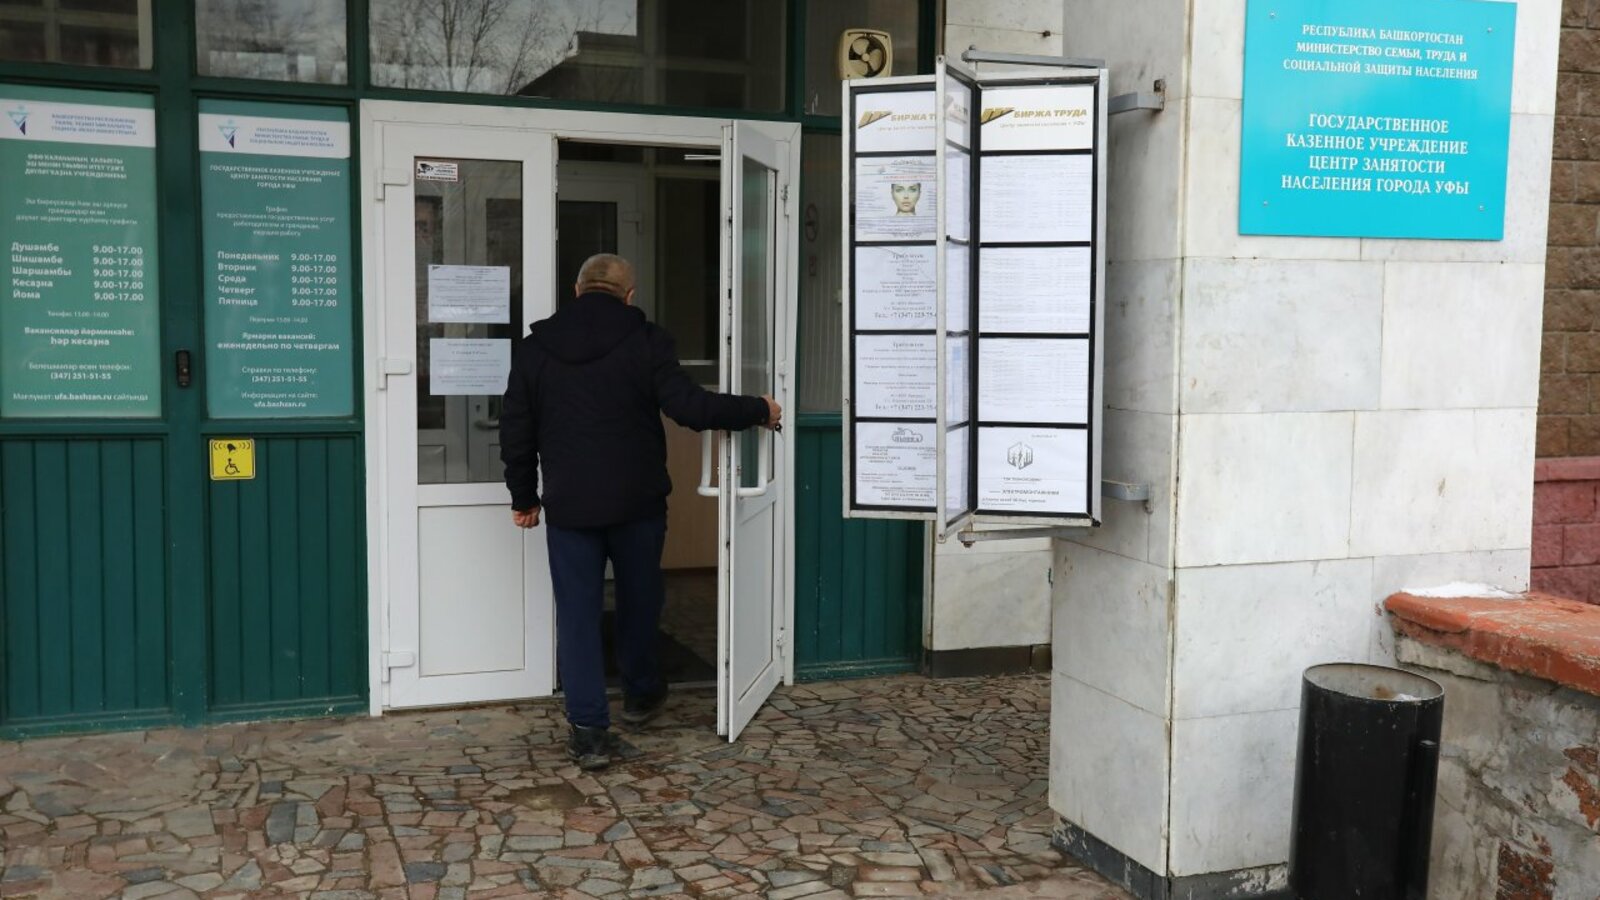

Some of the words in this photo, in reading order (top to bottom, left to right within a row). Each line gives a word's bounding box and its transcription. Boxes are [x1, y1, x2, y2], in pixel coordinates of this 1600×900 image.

[1302, 24, 1376, 39] РЕСПУБЛИКА
[1379, 29, 1464, 45] БАШКОРТОСТАН
[1296, 42, 1382, 56] МИНИСТЕРСТВО
[1385, 46, 1422, 60] СЕМЬИ,
[1425, 49, 1456, 62] ТРУДА
[1459, 51, 1467, 62] И
[1283, 58, 1361, 75] СОЦИАЛЬНОЙ
[1364, 63, 1412, 77] ЗАЩИТЫ
[1415, 66, 1478, 80] НАСЕЛЕНИЯ
[1013, 110, 1052, 119] БИРЖА
[1054, 108, 1087, 117] ТРУДА
[1309, 113, 1449, 133] ГОСУДАРСТВЕННОЕ
[1286, 133, 1365, 150] КАЗЕННОЕ
[1369, 138, 1468, 155] УЧРЕЖДЕНИЕ
[1309, 155, 1358, 172] ЦЕНТР
[1363, 158, 1445, 174] ЗАНЯТОСТИ
[1281, 175, 1371, 192] НАСЕЛЕНИЯ
[1376, 178, 1430, 194] ГОРОДА
[1435, 180, 1470, 195] УФЫ
[92, 245, 143, 255] 9.00-17.00
[93, 256, 143, 266] 9.00-17.00
[217, 251, 280, 261] Понедельник
[291, 253, 337, 262] 9.00-17.00
[93, 268, 143, 278] 9.00-17.00
[217, 263, 257, 272] Вторник
[291, 264, 337, 273] 9.00-17.00
[94, 280, 144, 290] 9.00-17.00
[218, 274, 246, 283] Среда
[291, 276, 337, 285] 9.00-17.00
[13, 289, 41, 299] Йома
[94, 291, 144, 301] 9.00-17.00
[218, 286, 256, 295] Четверг
[291, 287, 337, 296] 9.00-17.00
[218, 297, 258, 306] Пятница
[292, 299, 337, 307] 9.00-17.00
[217, 342, 279, 350] еженедельно
[293, 343, 340, 352] четвергам
